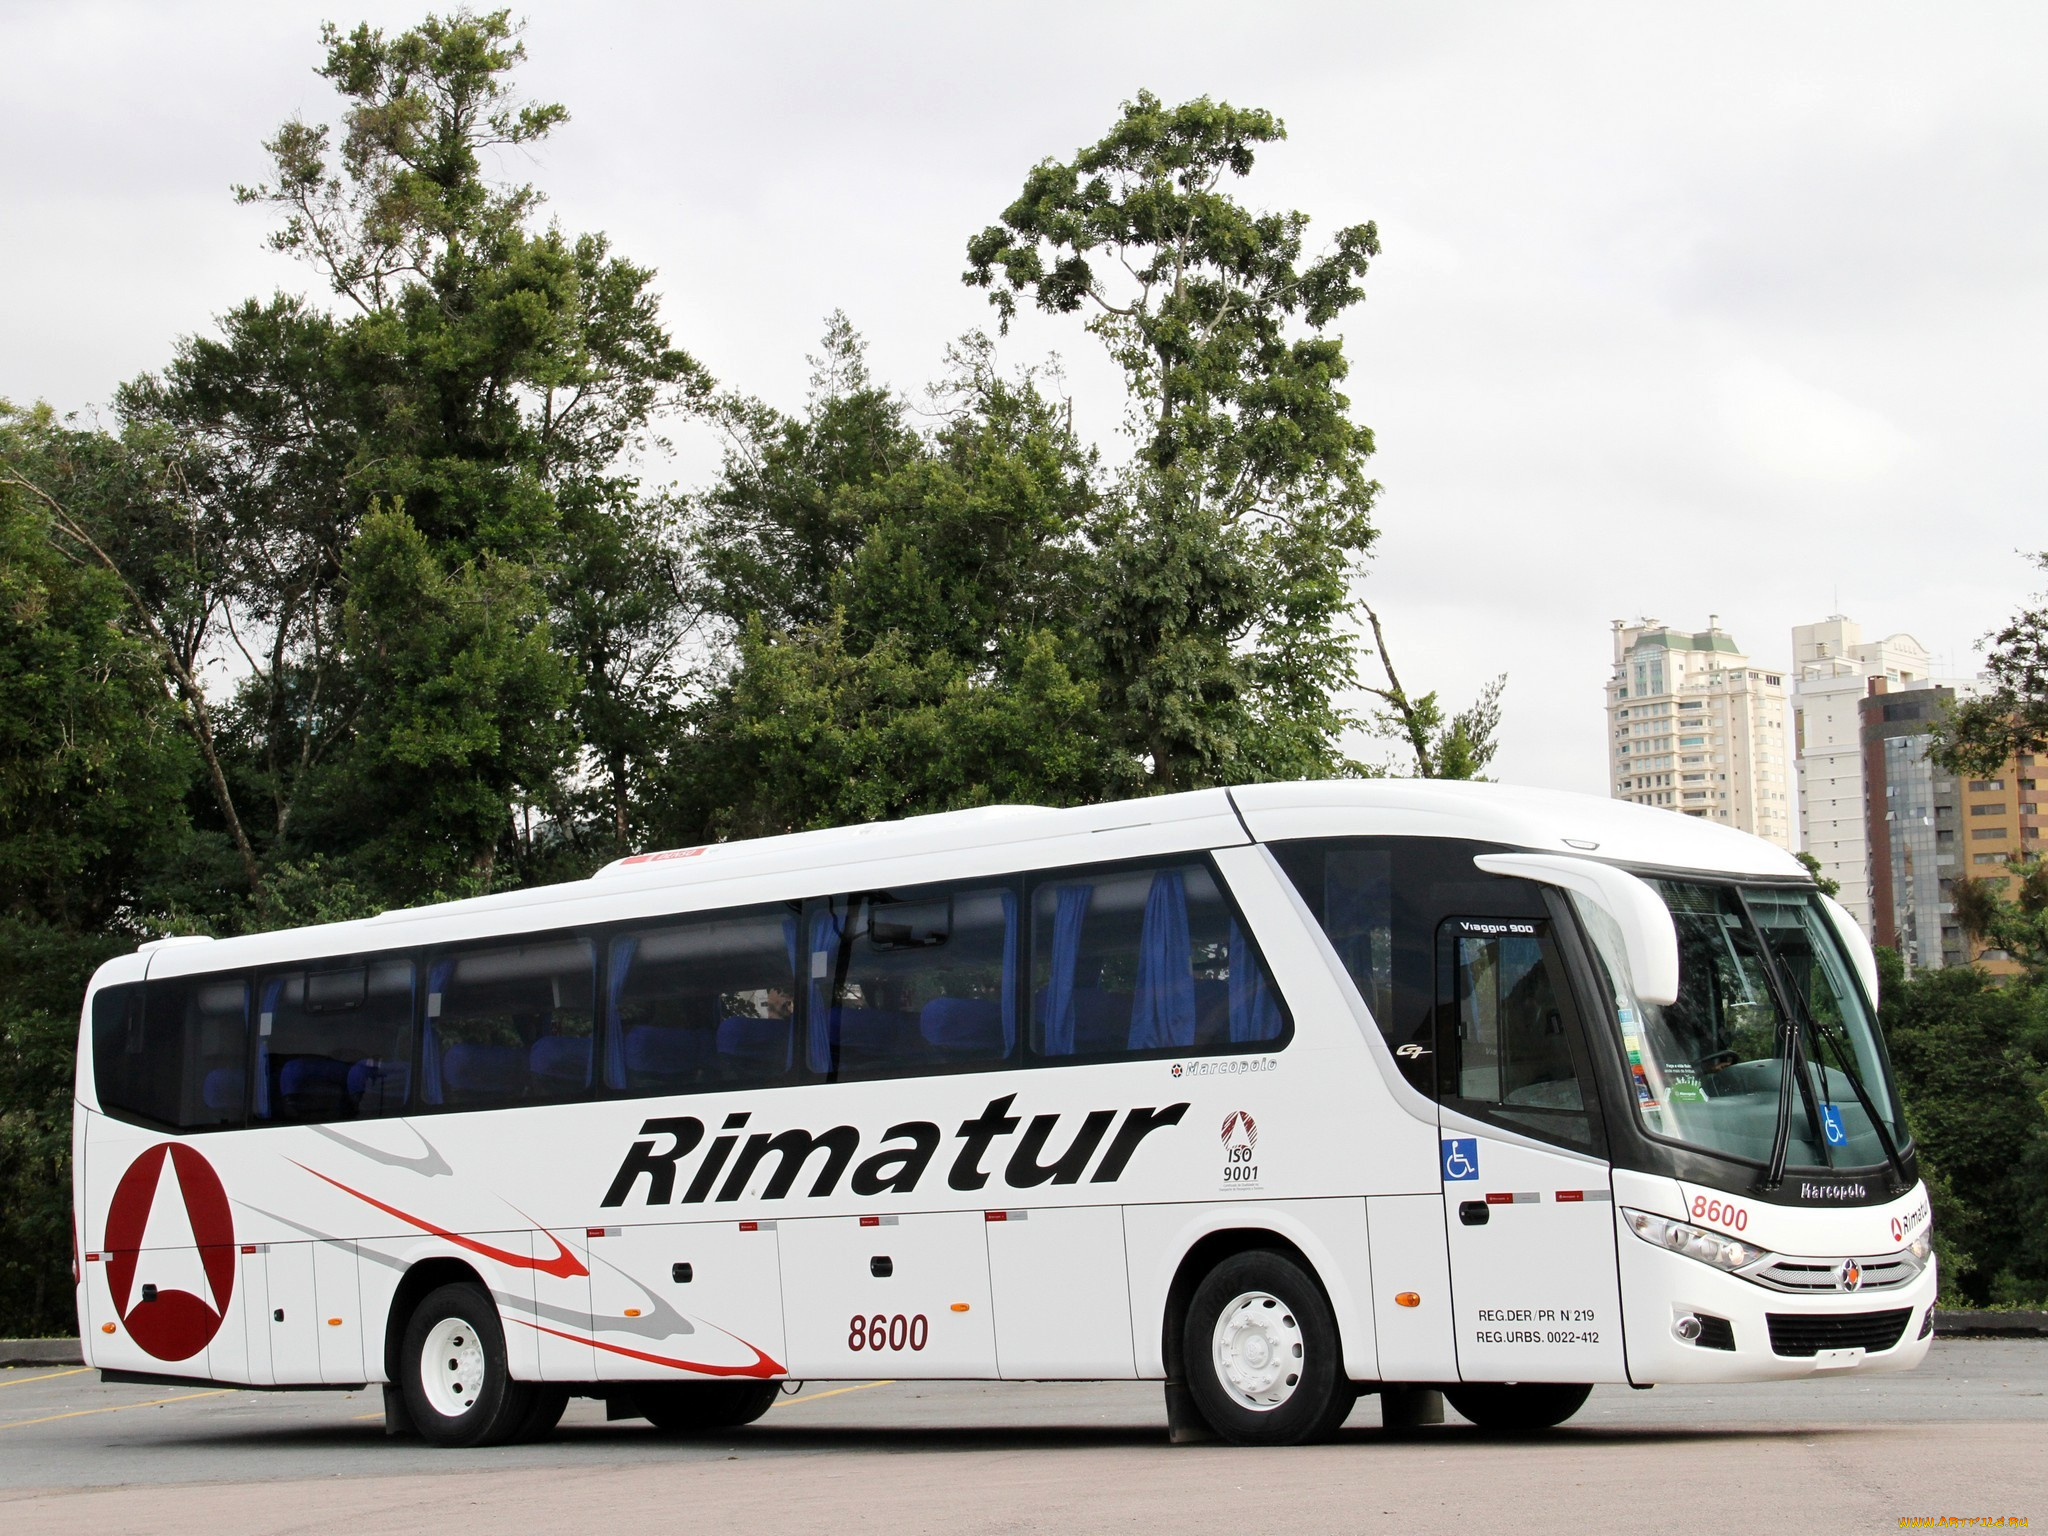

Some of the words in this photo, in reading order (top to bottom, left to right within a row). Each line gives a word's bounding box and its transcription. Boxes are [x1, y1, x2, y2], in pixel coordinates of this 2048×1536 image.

[1460, 922, 1508, 933] Viaggio
[1509, 924, 1534, 933] 900
[1186, 1057, 1278, 1077] Marcopolo
[600, 1092, 1191, 1208] Rimatur
[1228, 1147, 1253, 1163] ISO
[1223, 1165, 1258, 1181] 9001
[1800, 1183, 1866, 1200] Marcopolo
[1691, 1195, 1748, 1231] 8600
[847, 1313, 929, 1352] 8600
[1546, 1331, 1600, 1344] 0022-412
